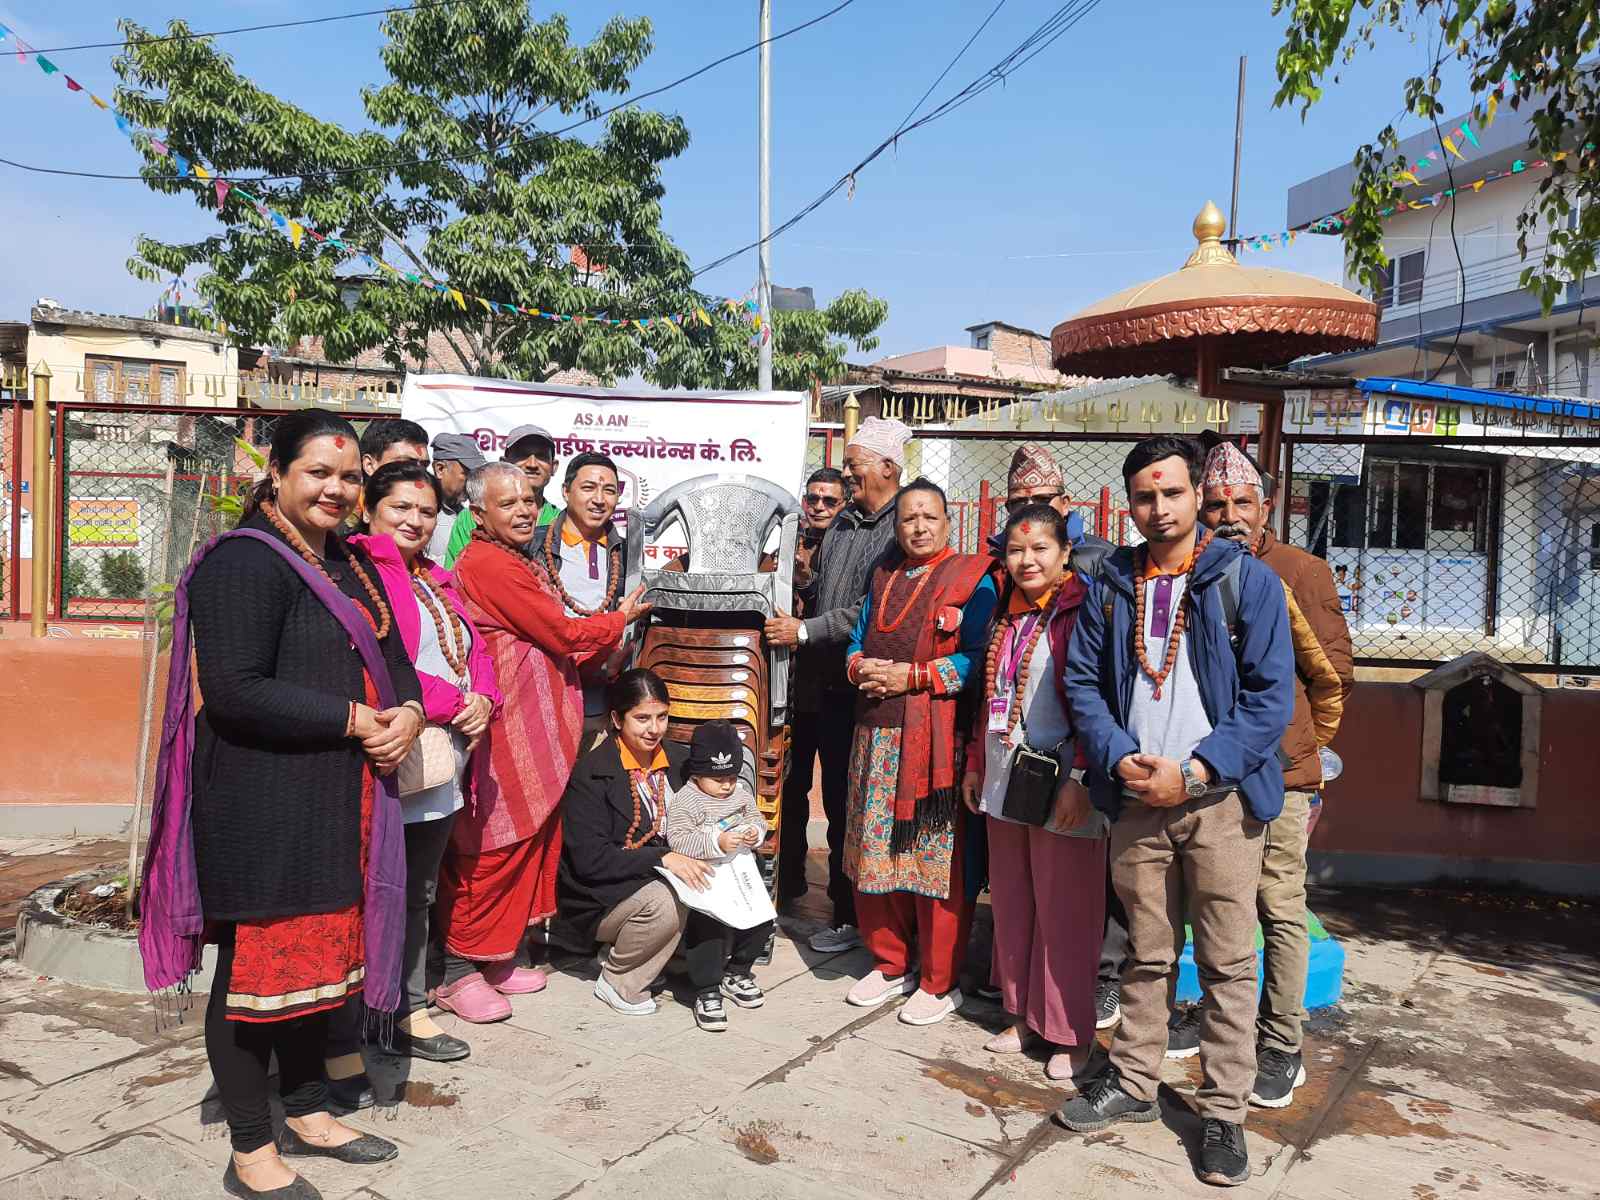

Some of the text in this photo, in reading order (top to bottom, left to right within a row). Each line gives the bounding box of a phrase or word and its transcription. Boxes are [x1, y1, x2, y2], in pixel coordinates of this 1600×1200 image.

[599, 436, 696, 460] इन्स्योरेन्स
[699, 438, 725, 461] कं.
[729, 438, 762, 462] लि.
